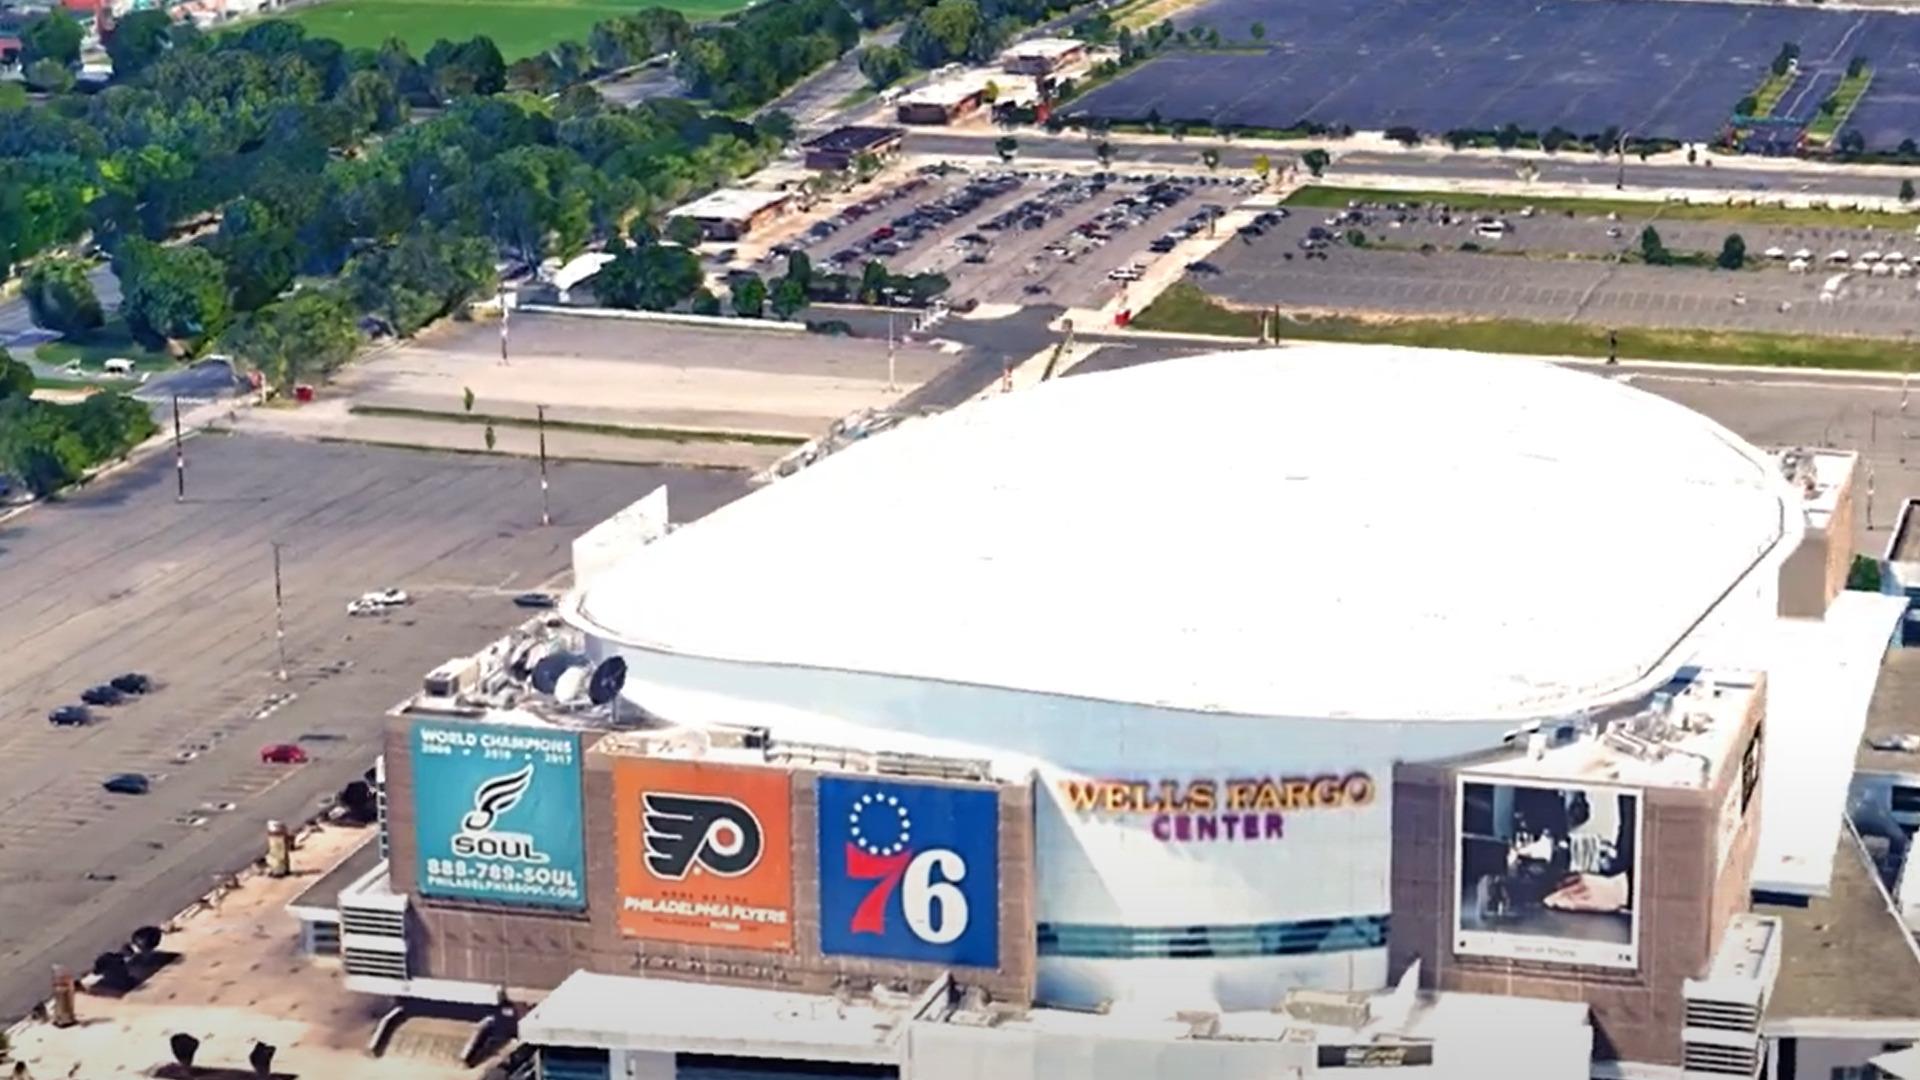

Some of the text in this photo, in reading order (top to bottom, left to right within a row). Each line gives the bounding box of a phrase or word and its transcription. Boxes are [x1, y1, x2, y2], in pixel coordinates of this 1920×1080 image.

[420, 729, 572, 754] WORLD CHAMPIONS
[1058, 771, 1375, 813] WELLS FARGO
[1152, 812, 1284, 842] CENTER
[454, 835, 544, 861] SOUL
[426, 858, 577, 887] 888-789-SOUL
[845, 842, 969, 944] 76
[623, 896, 788, 924] PHILADELPHIA FLYERS
